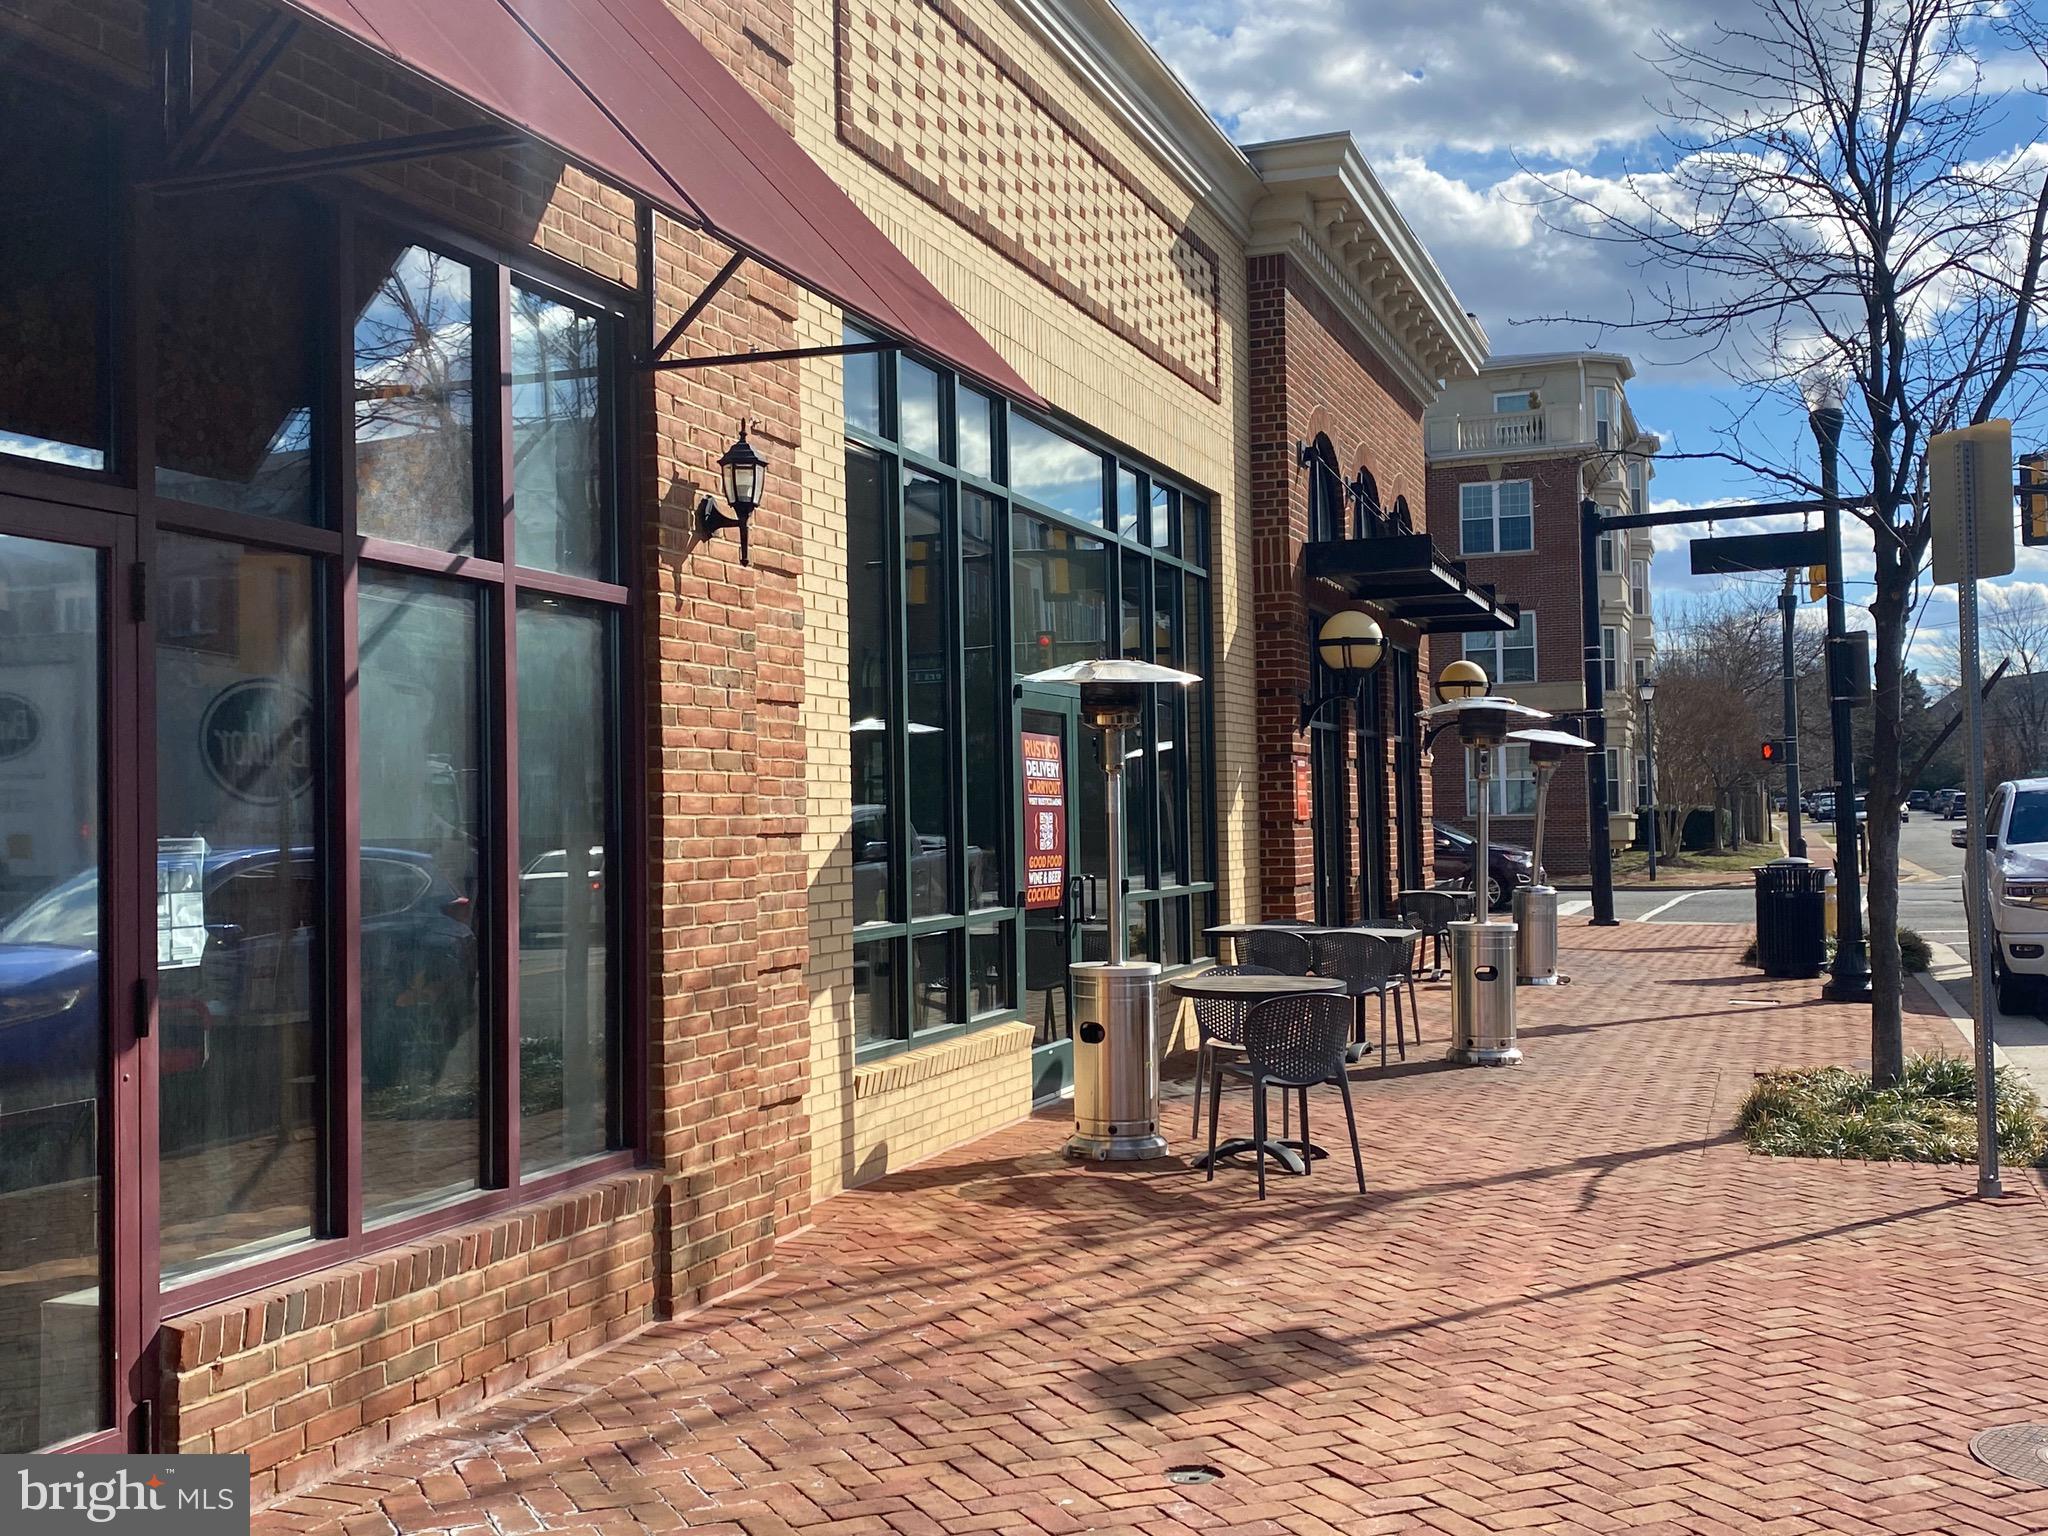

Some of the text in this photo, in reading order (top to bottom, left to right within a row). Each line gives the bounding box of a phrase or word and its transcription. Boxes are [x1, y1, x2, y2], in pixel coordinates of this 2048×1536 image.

[1024, 739, 1058, 759] RUSTICO
[1025, 760, 1059, 778] DELIVERY
[1027, 779, 1061, 795] CARRYOUT
[1028, 854, 1063, 869] GOOD FOOD
[1028, 870, 1062, 885] WINE & BEER
[1027, 886, 1061, 903] COCKTAILS
